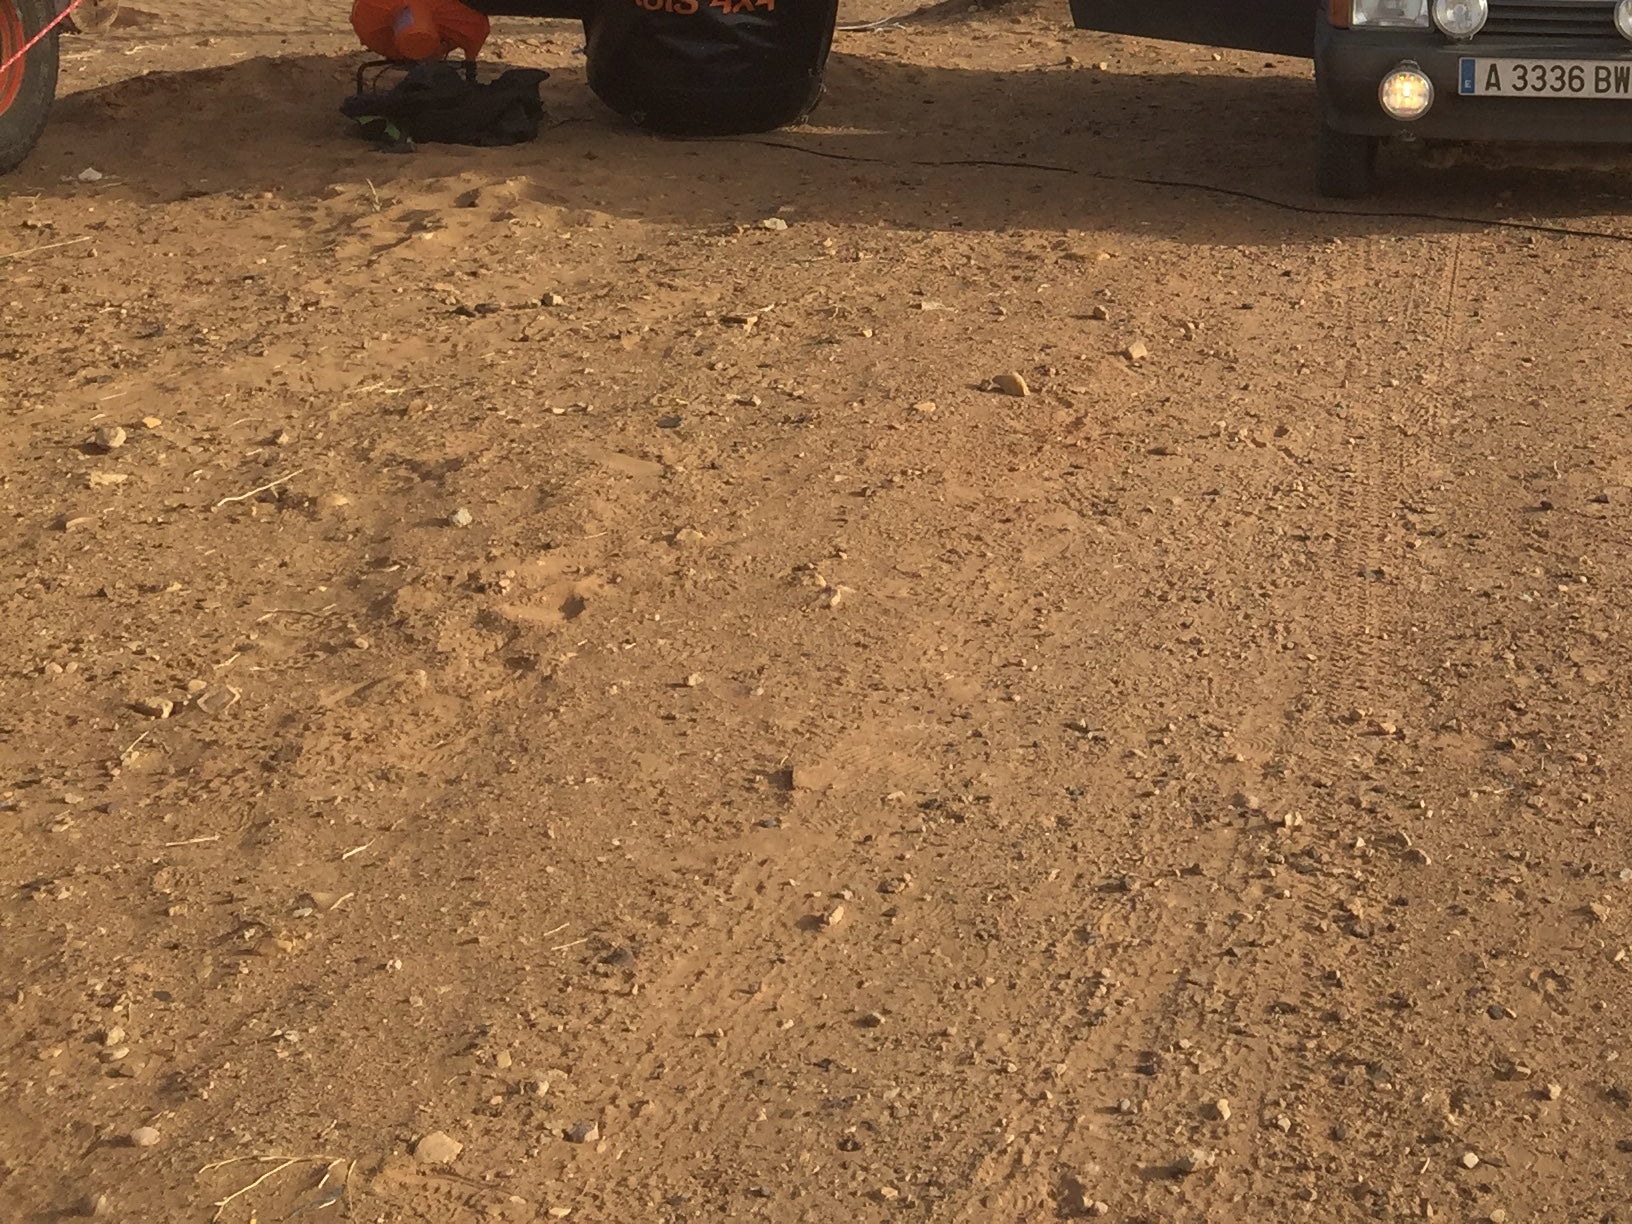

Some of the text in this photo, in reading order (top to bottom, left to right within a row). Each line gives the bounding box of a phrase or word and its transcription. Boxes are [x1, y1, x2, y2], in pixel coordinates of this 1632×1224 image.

[1464, 80, 1472, 88] E
[1484, 63, 1630, 94] A 3336 BW
